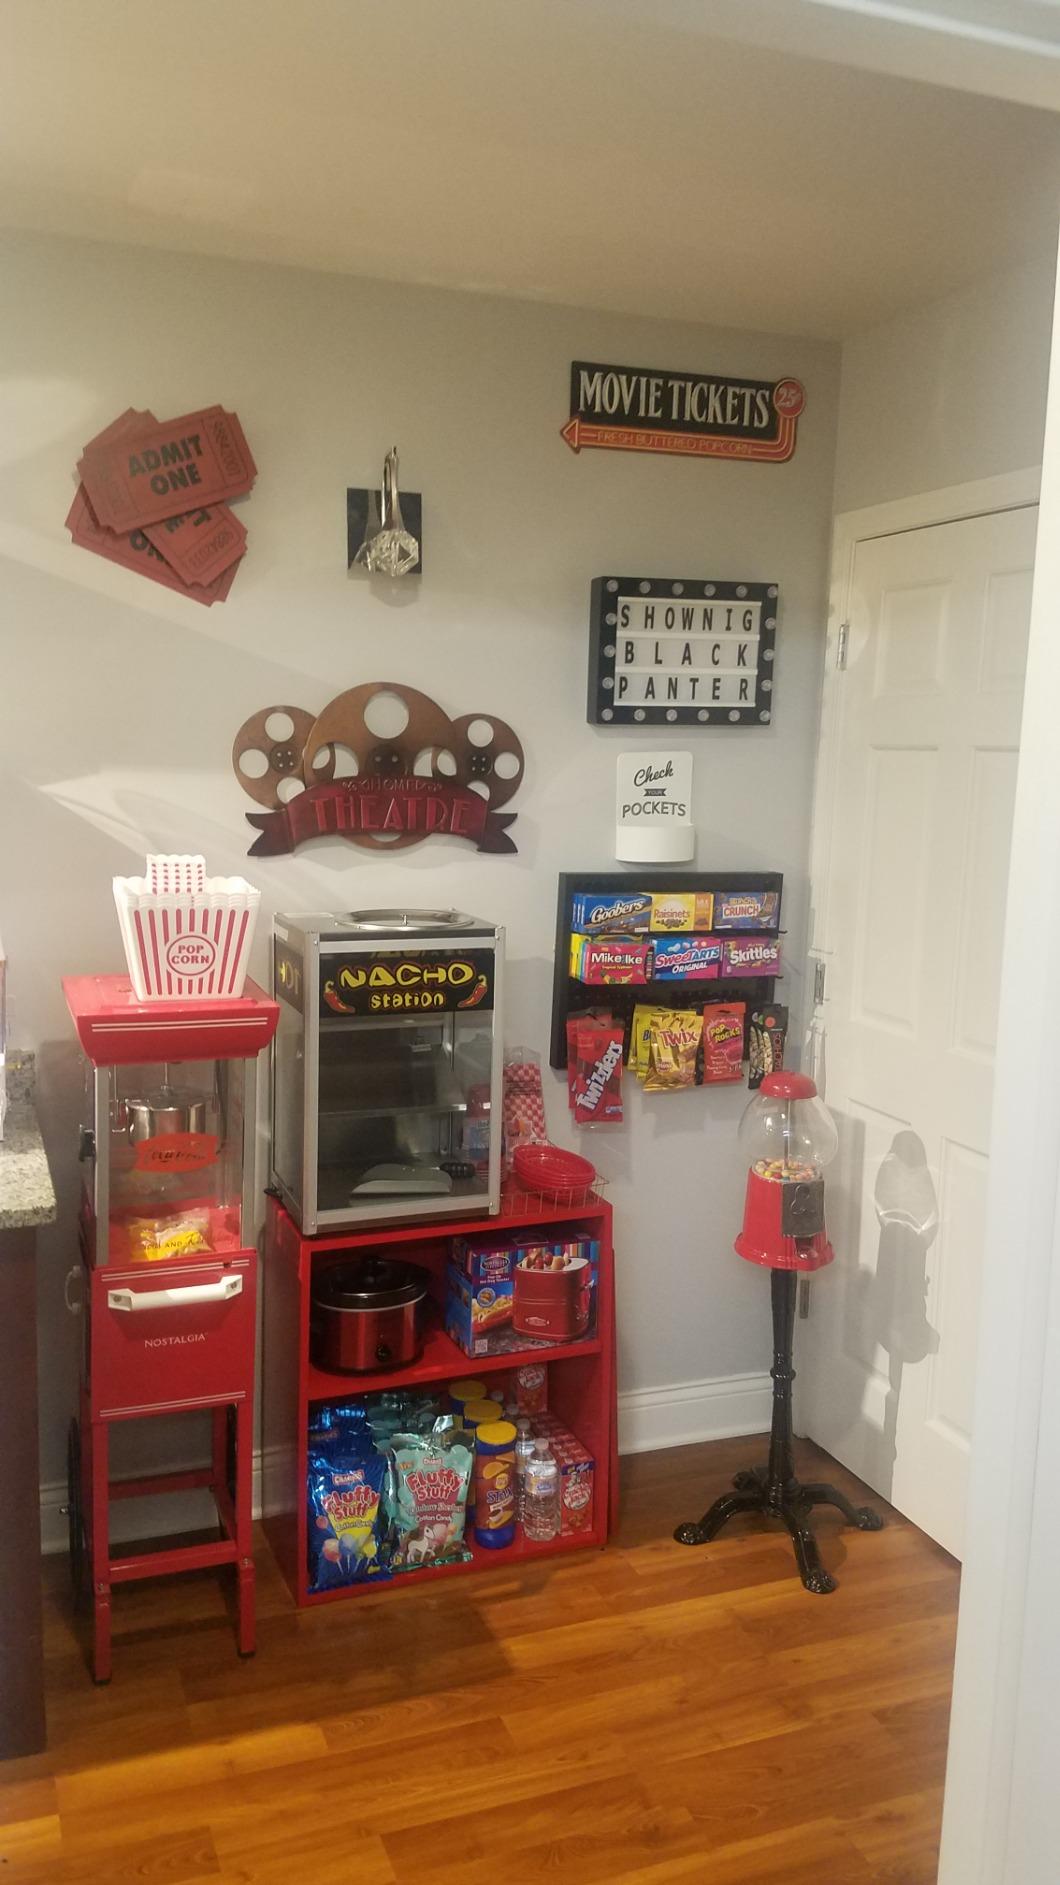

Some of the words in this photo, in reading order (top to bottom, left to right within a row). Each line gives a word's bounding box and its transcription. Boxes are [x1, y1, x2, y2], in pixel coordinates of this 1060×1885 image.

[578, 370, 663, 419] MOVIE
[668, 379, 770, 428] TICKETS
[597, 431, 633, 444] FRESH
[699, 440, 752, 454] POPCORN
[128, 433, 204, 478] ADMIT
[150, 462, 202, 496] ONE
[620, 604, 753, 631] SHOWNIG
[624, 641, 748, 666] BLACK
[618, 676, 749, 700] PANTER
[633, 760, 674, 787] Check
[309, 792, 473, 833] THEATRE
[622, 801, 687, 818] POCKETS
[591, 901, 644, 923] Goobers
[653, 908, 690, 919] Raisinets
[724, 905, 760, 917] CRUNCH
[177, 945, 204, 954] POP
[591, 952, 622, 963] Mike
[625, 954, 643, 964] Ike
[730, 946, 778, 964] Skittles
[171, 954, 210, 965] CORN
[672, 962, 708, 974] ORIGINAL
[340, 962, 475, 988] NACHO
[370, 991, 445, 1009] station
[660, 1029, 699, 1048] Twix
[710, 1023, 726, 1037] POP
[715, 1027, 740, 1043] ROCKS
[144, 1333, 206, 1349] NOSTALGIA
[417, 1487, 451, 1501] Stuff
[334, 1502, 368, 1521] Stuff
